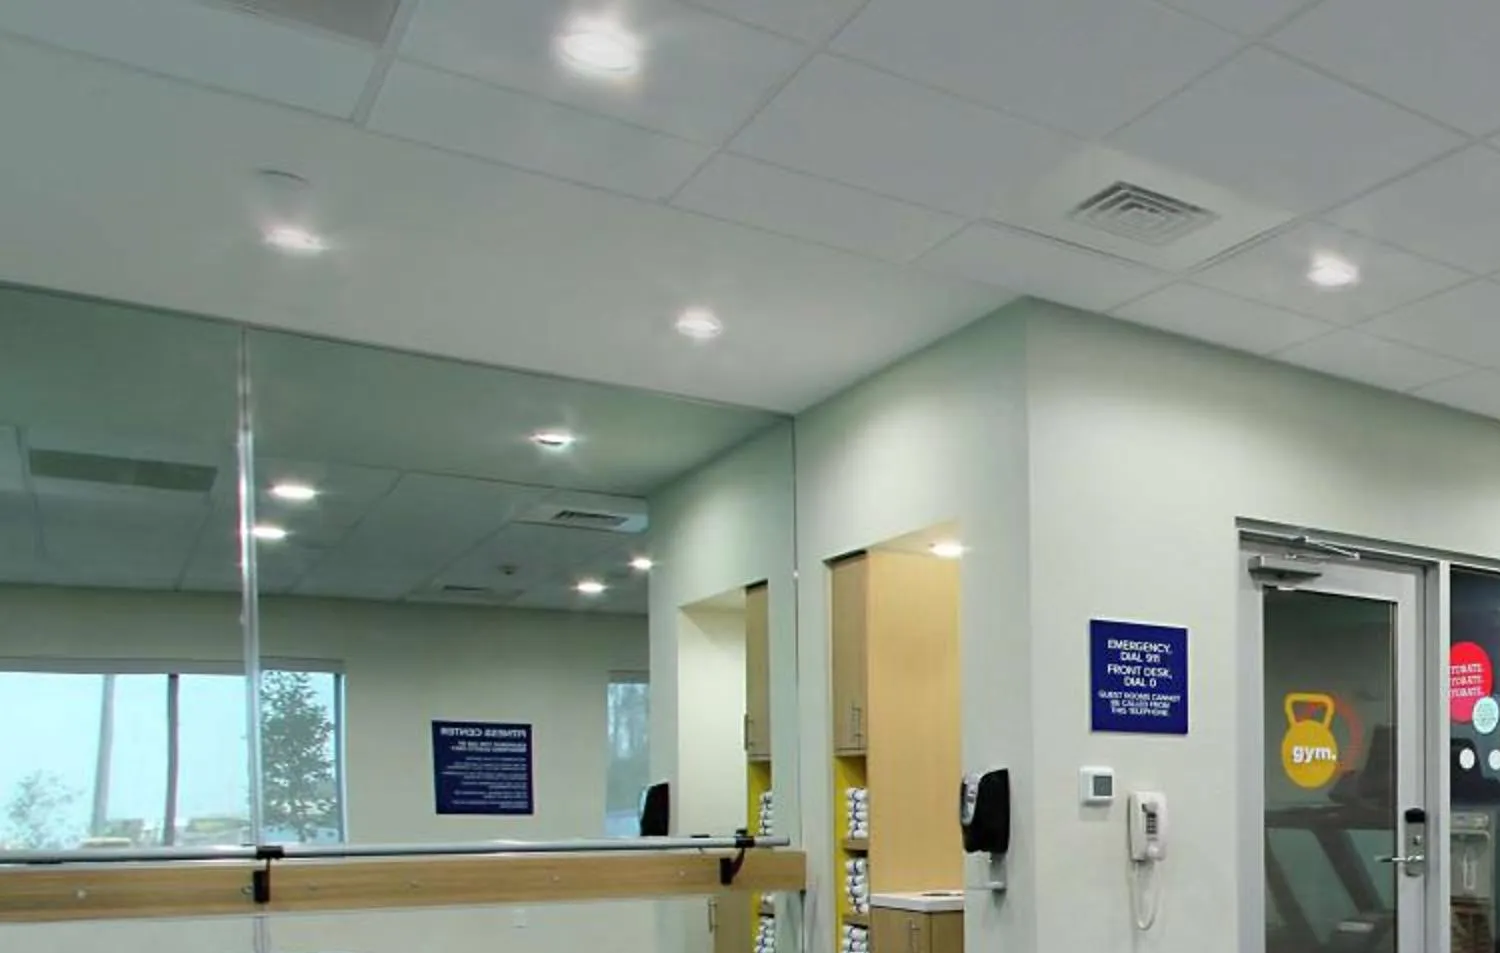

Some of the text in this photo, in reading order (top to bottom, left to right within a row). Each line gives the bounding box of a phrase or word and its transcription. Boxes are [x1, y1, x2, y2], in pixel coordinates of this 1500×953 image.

[1120, 651, 1161, 663] DIAL 911
[1107, 664, 1142, 675] FRONT
[1123, 676, 1146, 687] DIAL
